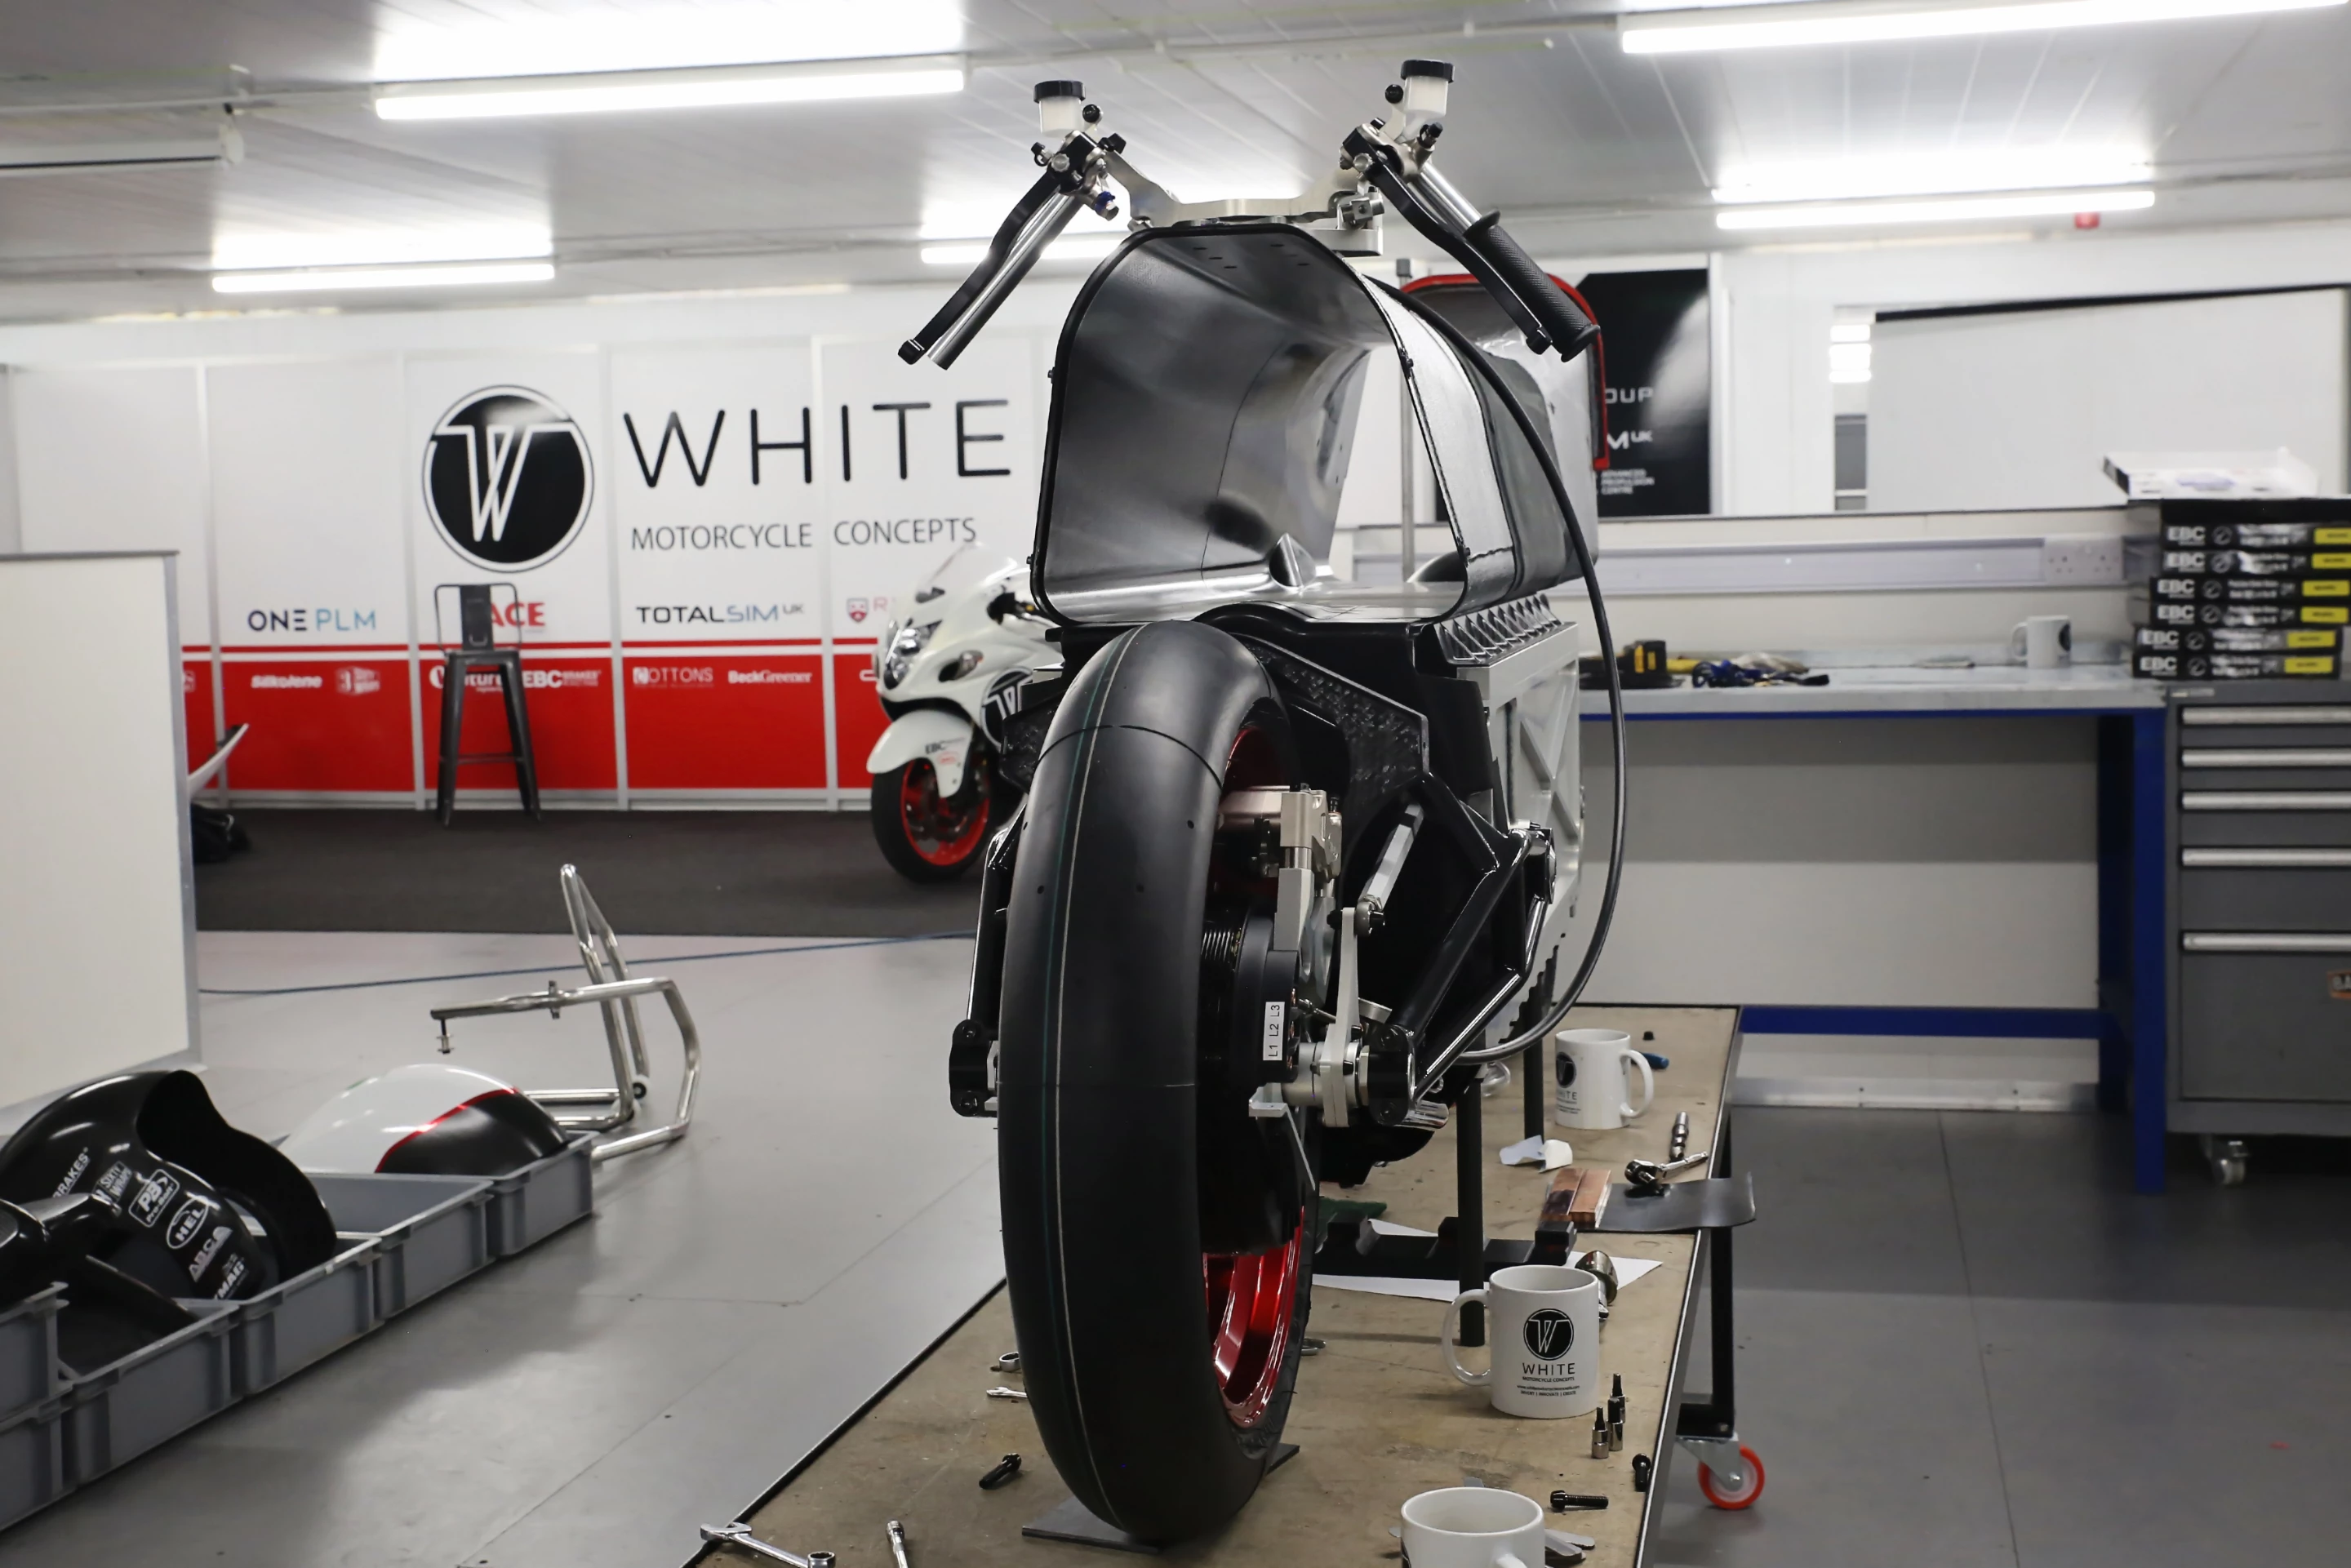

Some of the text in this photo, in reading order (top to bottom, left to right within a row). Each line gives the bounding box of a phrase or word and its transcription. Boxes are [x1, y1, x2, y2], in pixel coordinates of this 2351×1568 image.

[624, 399, 1011, 487] WHITE
[632, 517, 977, 550] MOTORCYCLE CONCEPTS
[248, 608, 376, 632] ONE PLM
[522, 669, 562, 689] EBC
[1268, 1004, 1280, 1057] L1 L2 L3
[175, 1208, 205, 1242] HEL
[1522, 1362, 1575, 1375] WHITE
